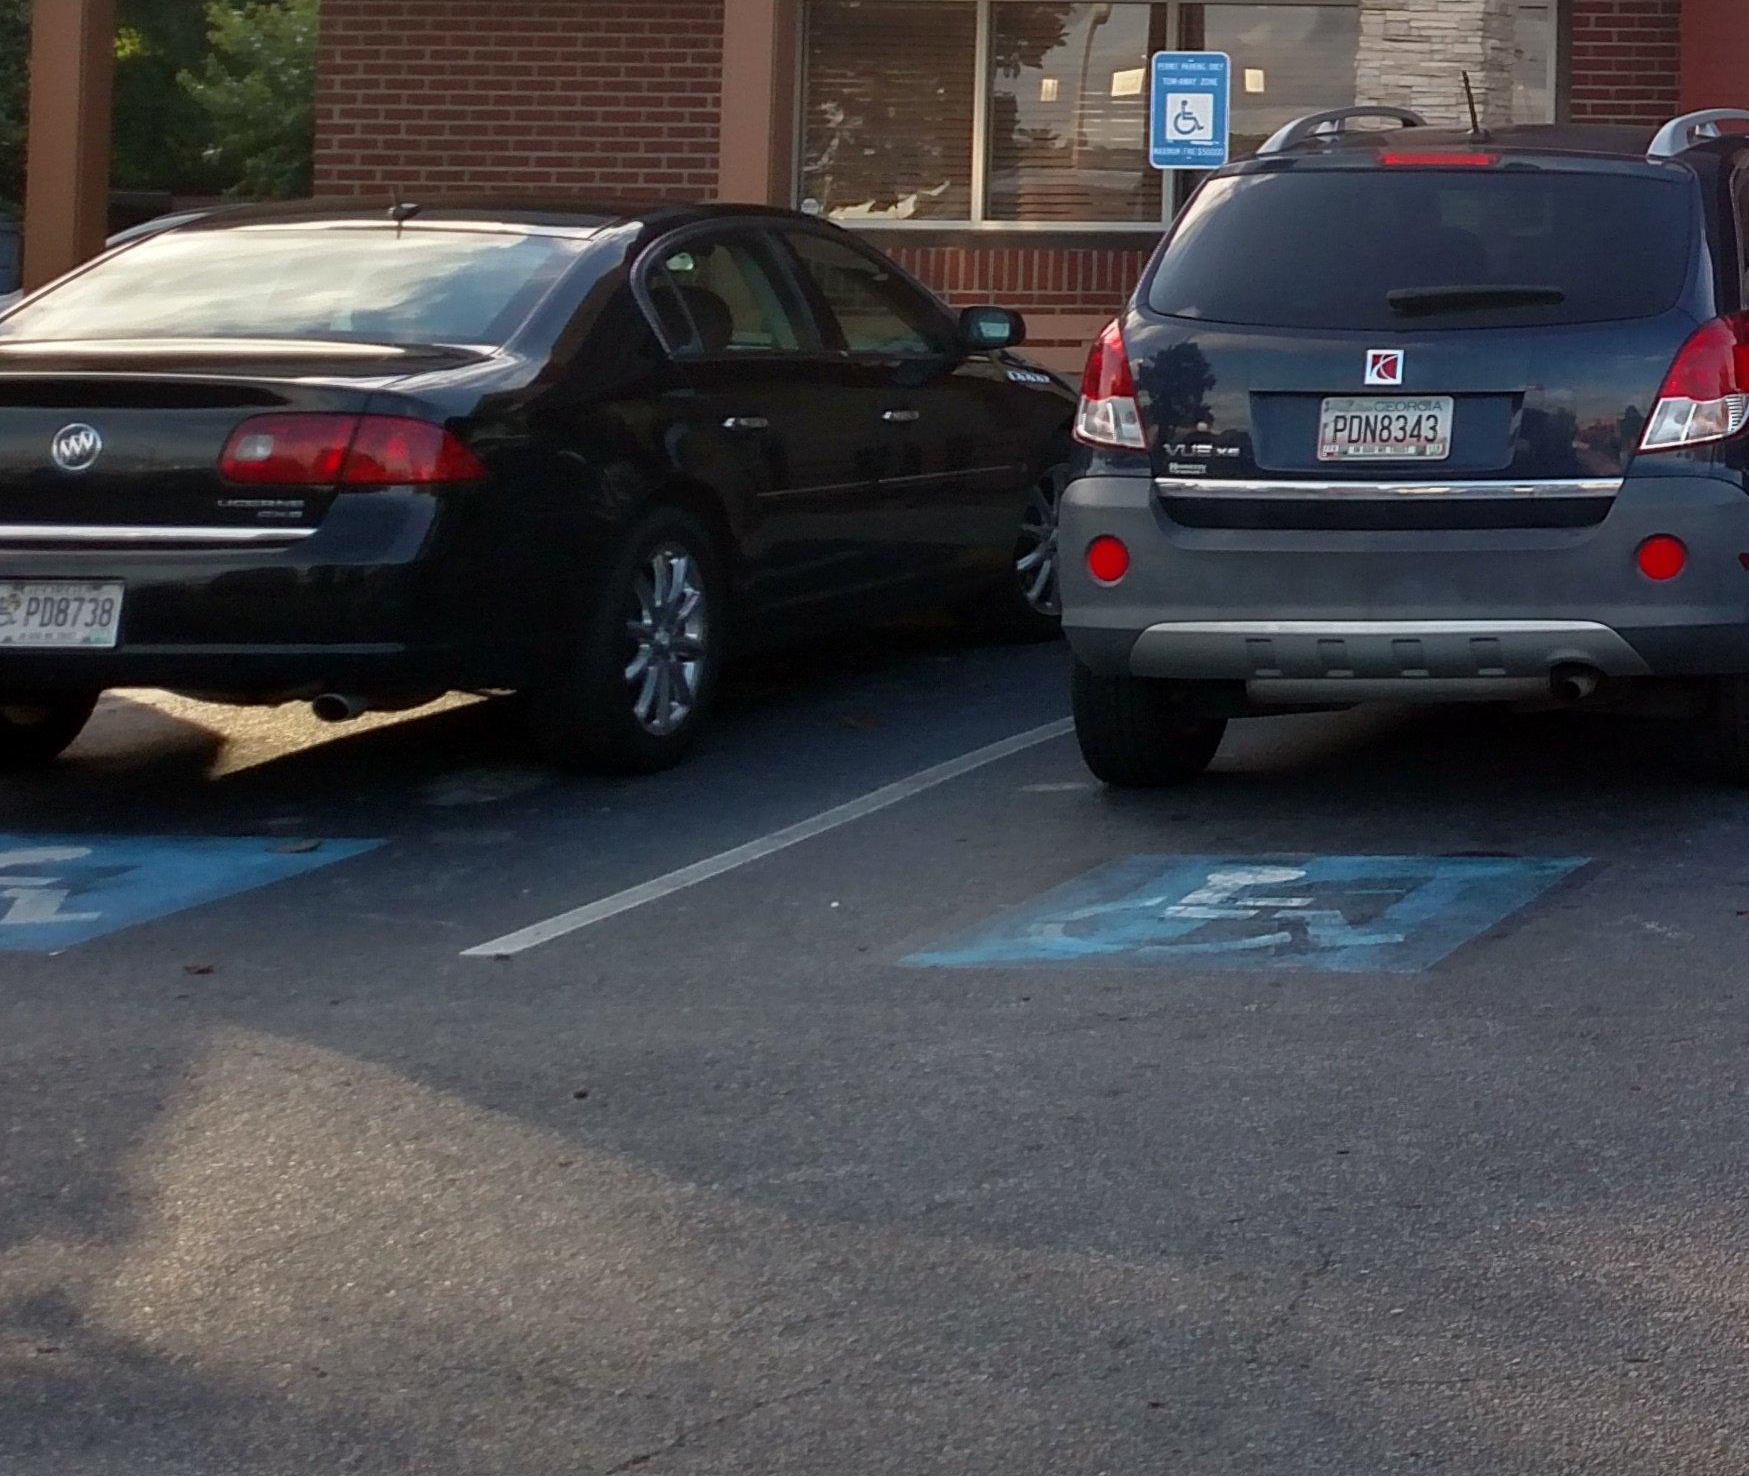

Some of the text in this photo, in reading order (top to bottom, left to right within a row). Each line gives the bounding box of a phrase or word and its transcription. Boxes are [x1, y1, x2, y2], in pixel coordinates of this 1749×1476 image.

[1374, 401, 1443, 411] GEORGIA
[1333, 414, 1439, 443] PDN8343
[1163, 444, 1213, 457] VUE
[23, 596, 115, 628] PD8738
